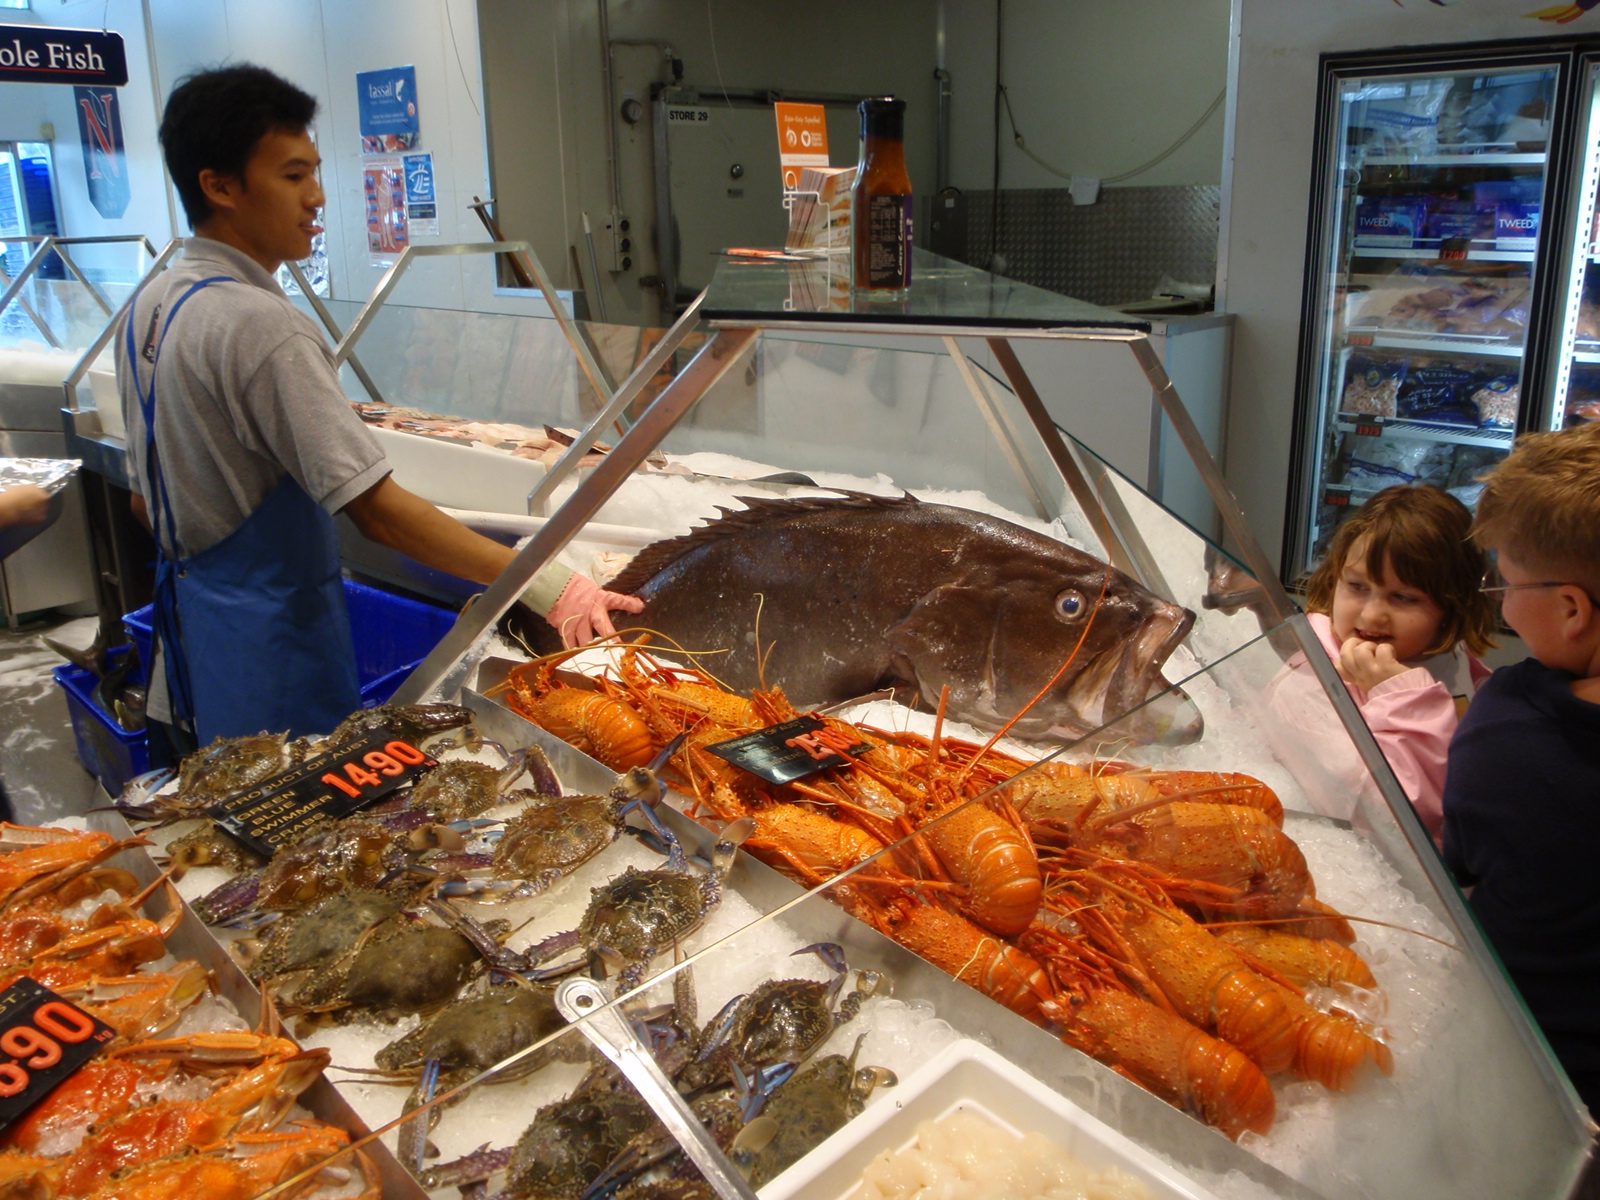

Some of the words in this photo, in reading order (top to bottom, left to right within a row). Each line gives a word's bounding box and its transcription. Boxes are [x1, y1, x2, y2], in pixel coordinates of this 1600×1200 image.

[0, 39, 40, 67] ole
[45, 43, 106, 71] Fish
[669, 110, 695, 120] STORE
[697, 111, 709, 121] 29
[306, 756, 328, 772] OF
[236, 789, 297, 822] GREEN
[250, 793, 334, 838] SWIMMER
[252, 800, 298, 826] BLUE
[267, 812, 326, 845] CRABS
